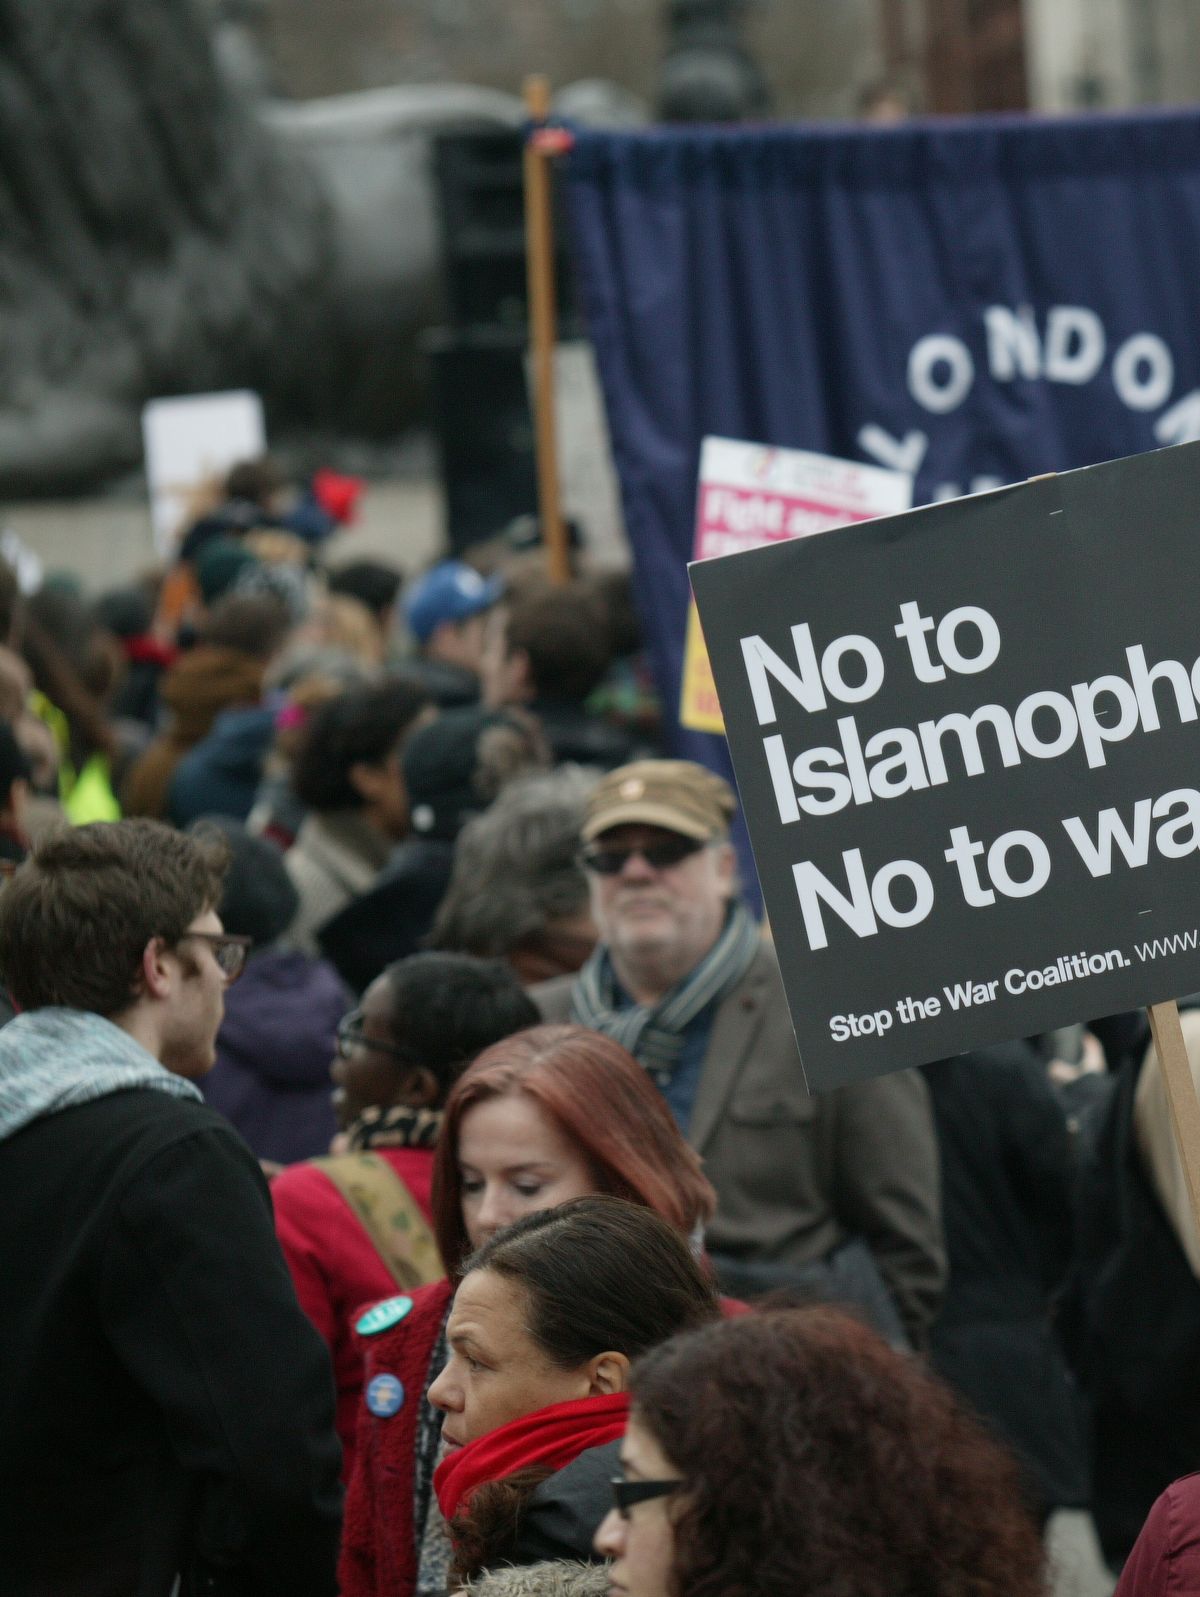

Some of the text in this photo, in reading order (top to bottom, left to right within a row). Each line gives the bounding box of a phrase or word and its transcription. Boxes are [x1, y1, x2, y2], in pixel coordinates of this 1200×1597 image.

[739, 622, 886, 726] No
[894, 600, 1001, 684] to
[791, 847, 935, 951] No
[943, 825, 1051, 908] to
[829, 1008, 893, 1043] Stop
[895, 996, 942, 1024] the
[942, 980, 1000, 1011] War
[1004, 949, 1131, 995] Coalition.
